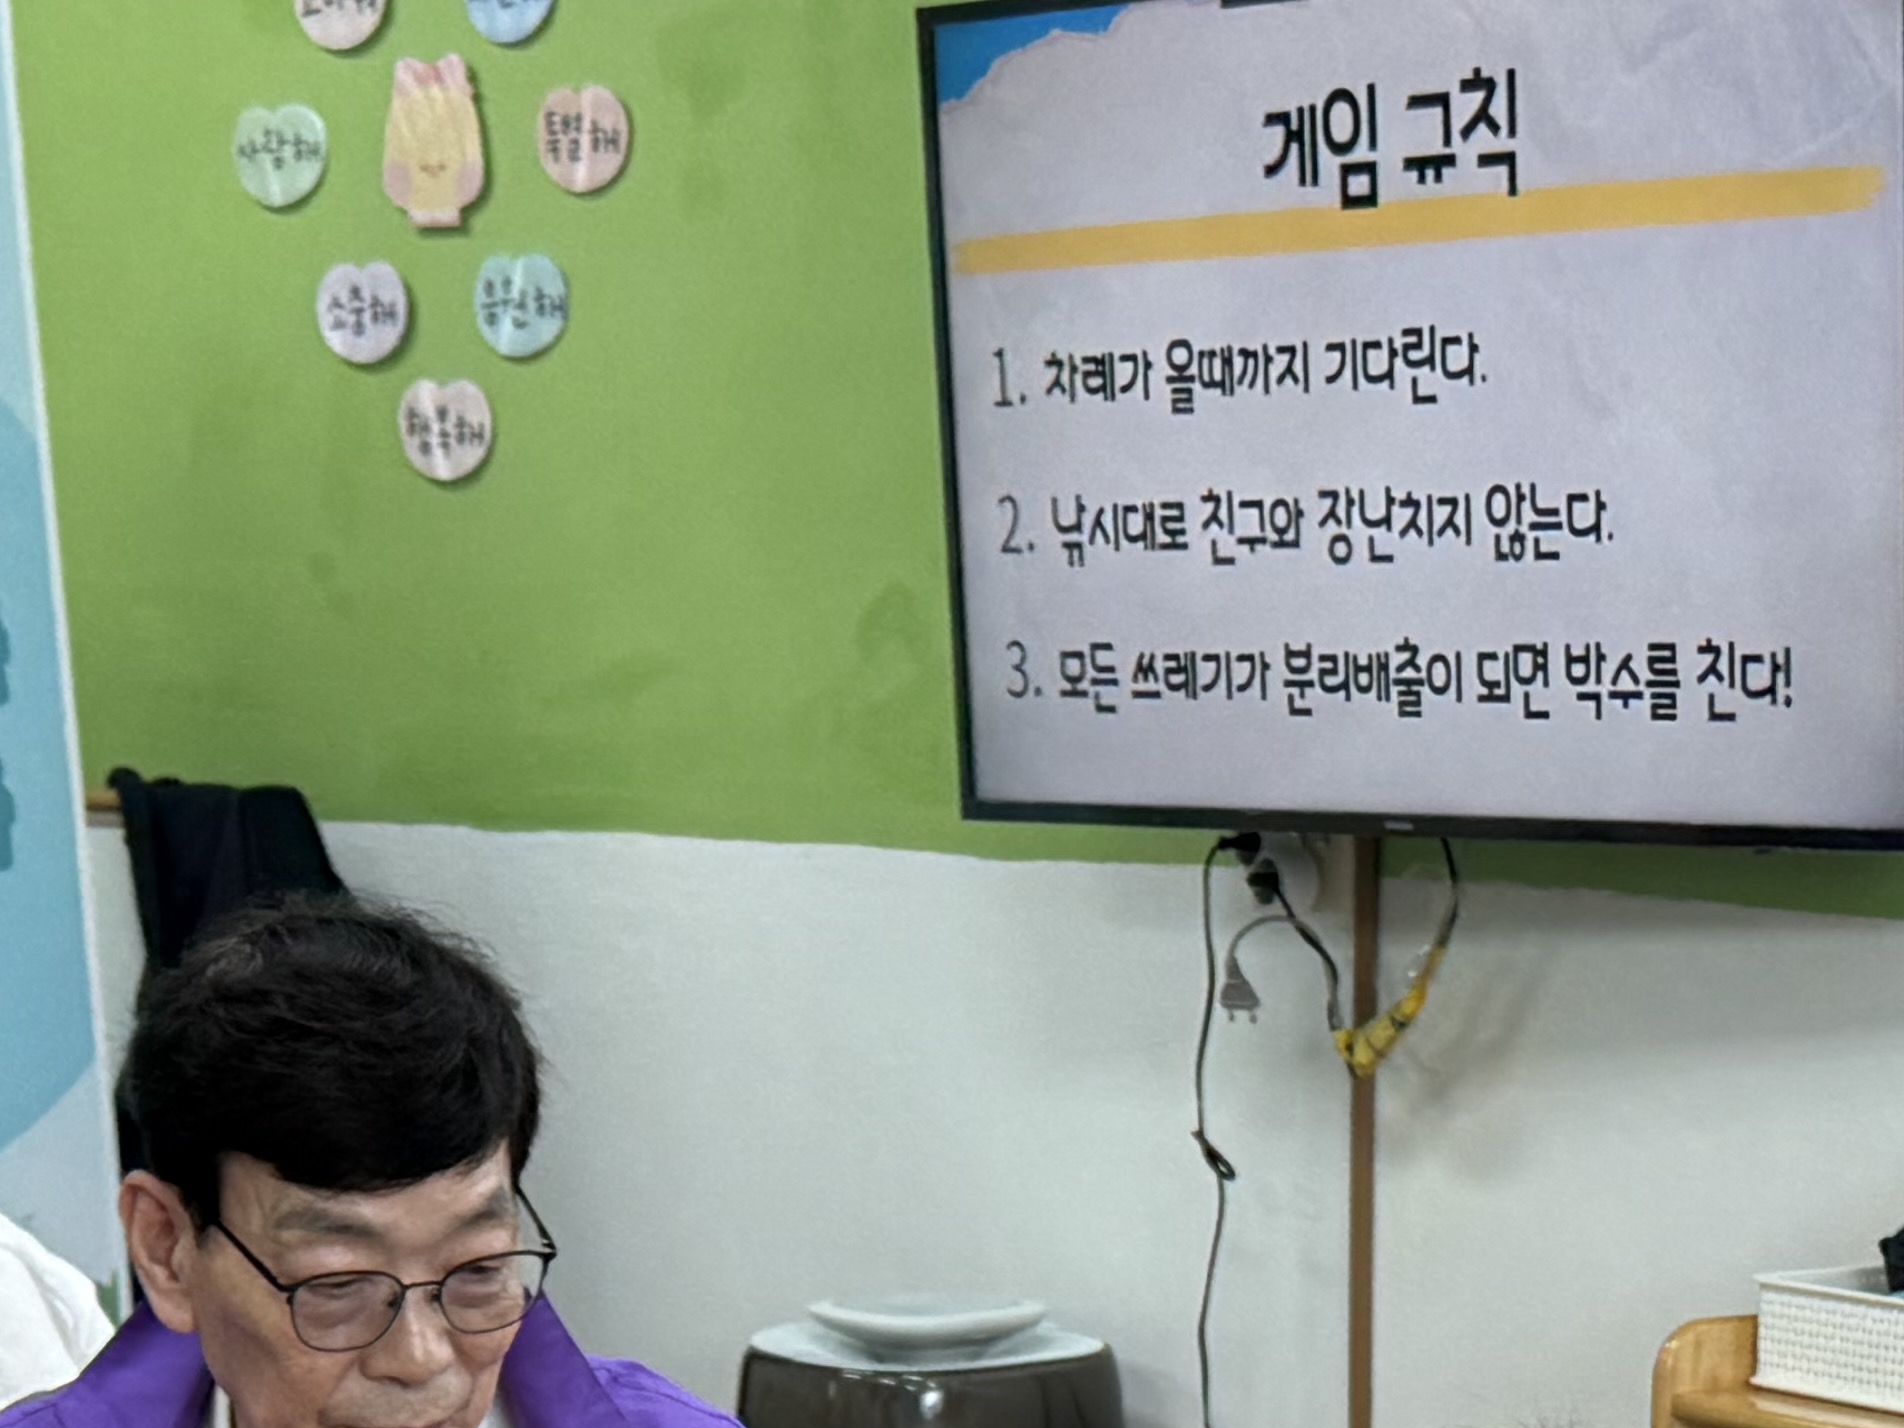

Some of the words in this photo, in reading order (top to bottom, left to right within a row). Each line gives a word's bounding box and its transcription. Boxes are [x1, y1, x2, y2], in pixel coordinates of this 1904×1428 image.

[1264, 83, 1378, 210] 게임
[1404, 68, 1516, 196] 규칙
[993, 348, 1026, 407] 1.
[1045, 350, 1152, 403] 차례가
[1166, 339, 1309, 414] 올때까지
[1325, 325, 1486, 404] 기다린다.
[998, 495, 1034, 554] 2.
[1052, 495, 1188, 567] 낚시대로
[1200, 489, 1304, 565] 친구와
[1318, 486, 1471, 565] 장난치지
[1486, 483, 1613, 562] 않는다.
[1007, 640, 1042, 698] 3.
[1060, 643, 1119, 713] 모든
[1132, 651, 1270, 700] 쓰레기가
[1284, 637, 1462, 717] 분리배출이
[1477, 642, 1550, 719] 되면
[1565, 642, 1680, 721] 박수를
[1697, 638, 1792, 722] 친다!
